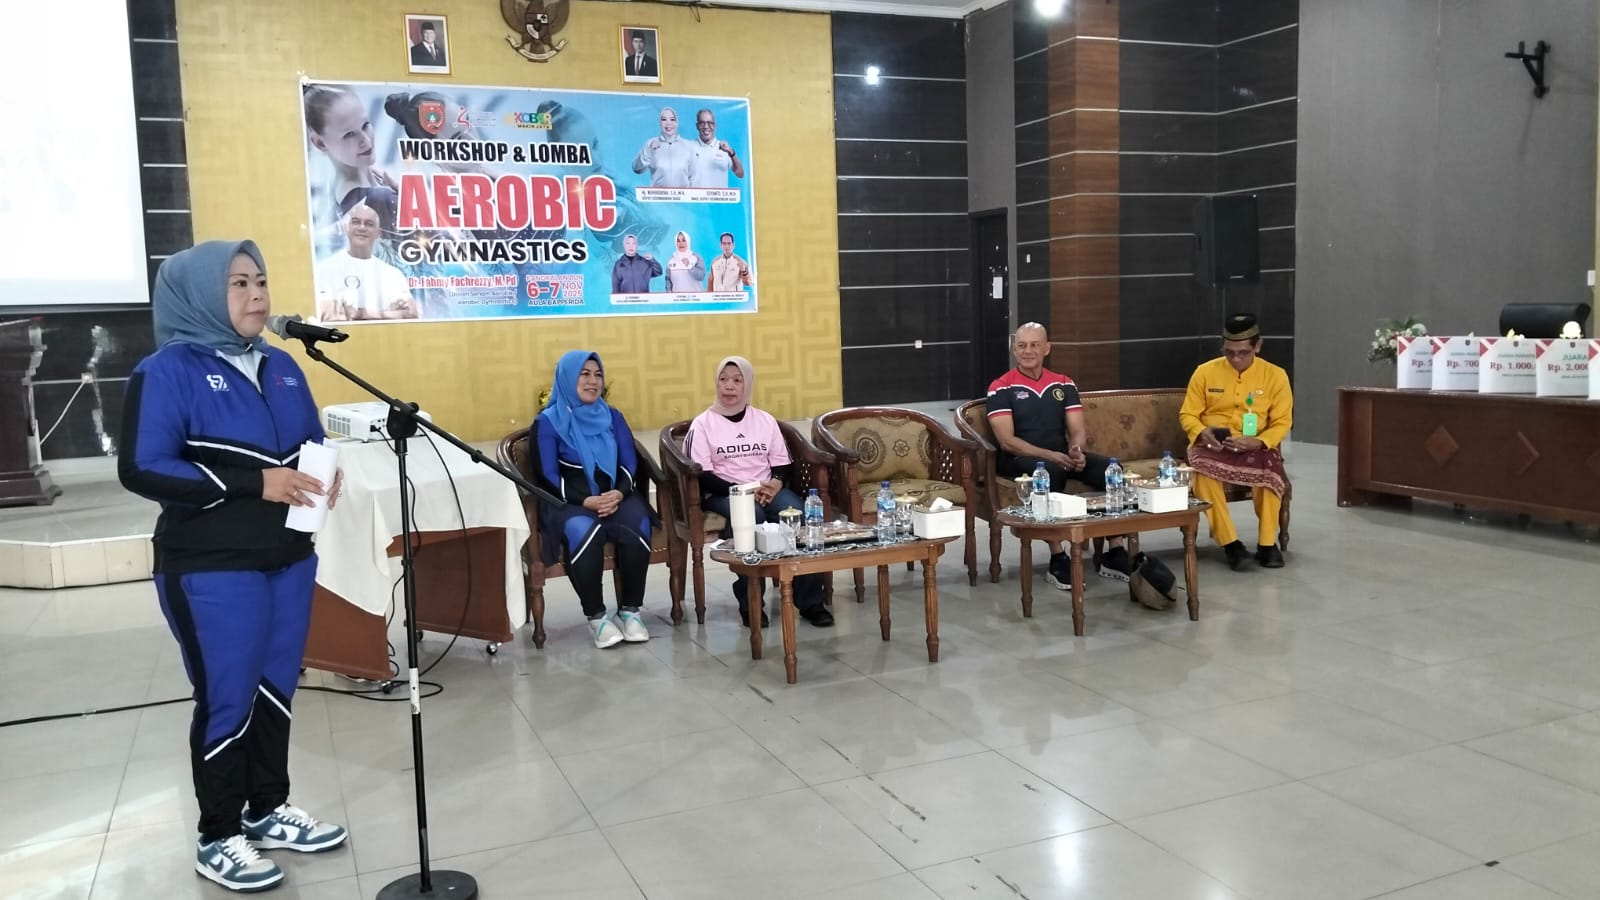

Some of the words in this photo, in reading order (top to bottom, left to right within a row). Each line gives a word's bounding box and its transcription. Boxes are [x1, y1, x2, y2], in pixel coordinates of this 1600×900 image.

[399, 140, 508, 162] WORKSHOP
[513, 146, 526, 162] &
[530, 143, 591, 164] LOMBA
[399, 174, 615, 229] AEROBIC
[400, 241, 587, 263] GYMNASTICS
[562, 282, 583, 290] NOV
[1563, 353, 1589, 361] JUARA
[1411, 359, 1426, 368] Rp.
[1447, 360, 1462, 369] Rp.
[1490, 361, 1504, 371] Rp.
[1507, 362, 1536, 370] 1.000.
[1547, 363, 1564, 373] Rp.
[716, 443, 768, 455] ADIDAS
